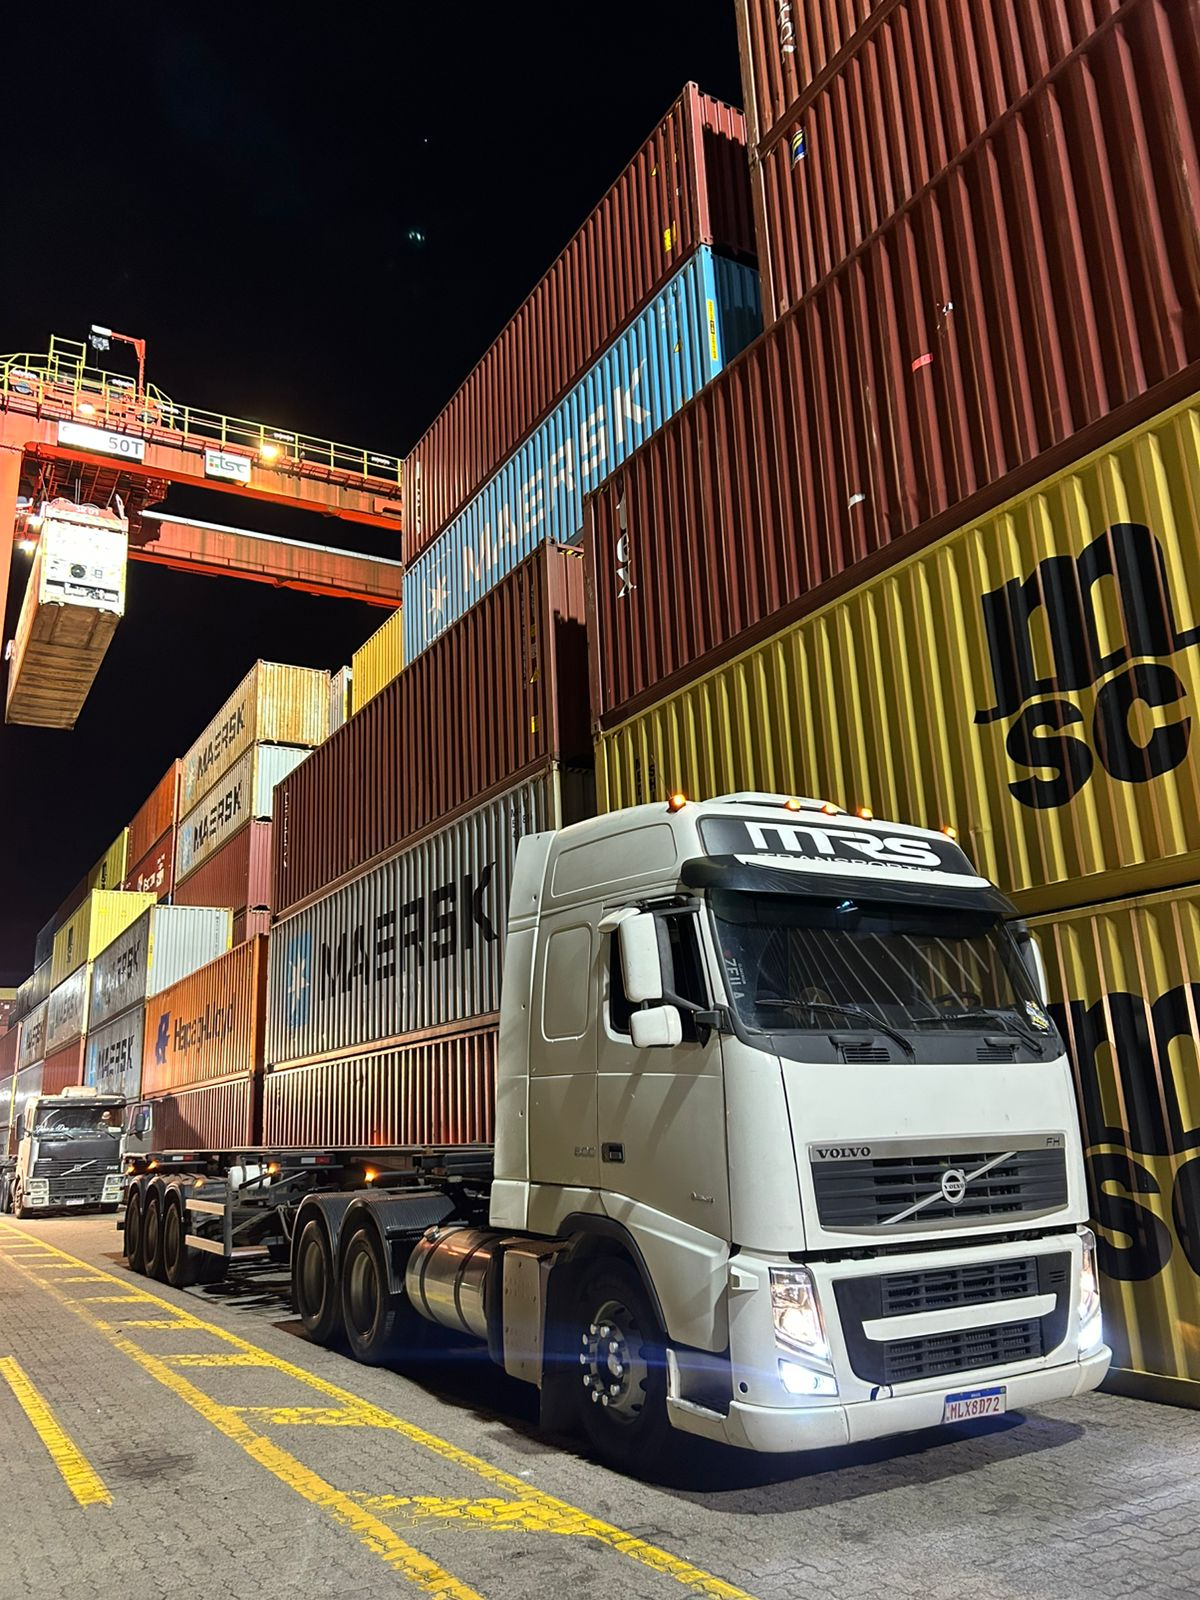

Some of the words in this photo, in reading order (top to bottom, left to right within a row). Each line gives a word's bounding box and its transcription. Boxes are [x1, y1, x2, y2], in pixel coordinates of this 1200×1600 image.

[108, 436, 143, 455] 50T
[462, 358, 652, 593] MAERSK
[197, 699, 247, 781] MAERSK
[193, 779, 243, 852] MAERSK
[744, 821, 942, 867] MRS
[320, 862, 499, 1001] MAERSK
[816, 1146, 871, 1159] VOLVO
[1046, 1137, 1061, 1148] FH
[950, 1396, 1000, 1420] MLX8D72
